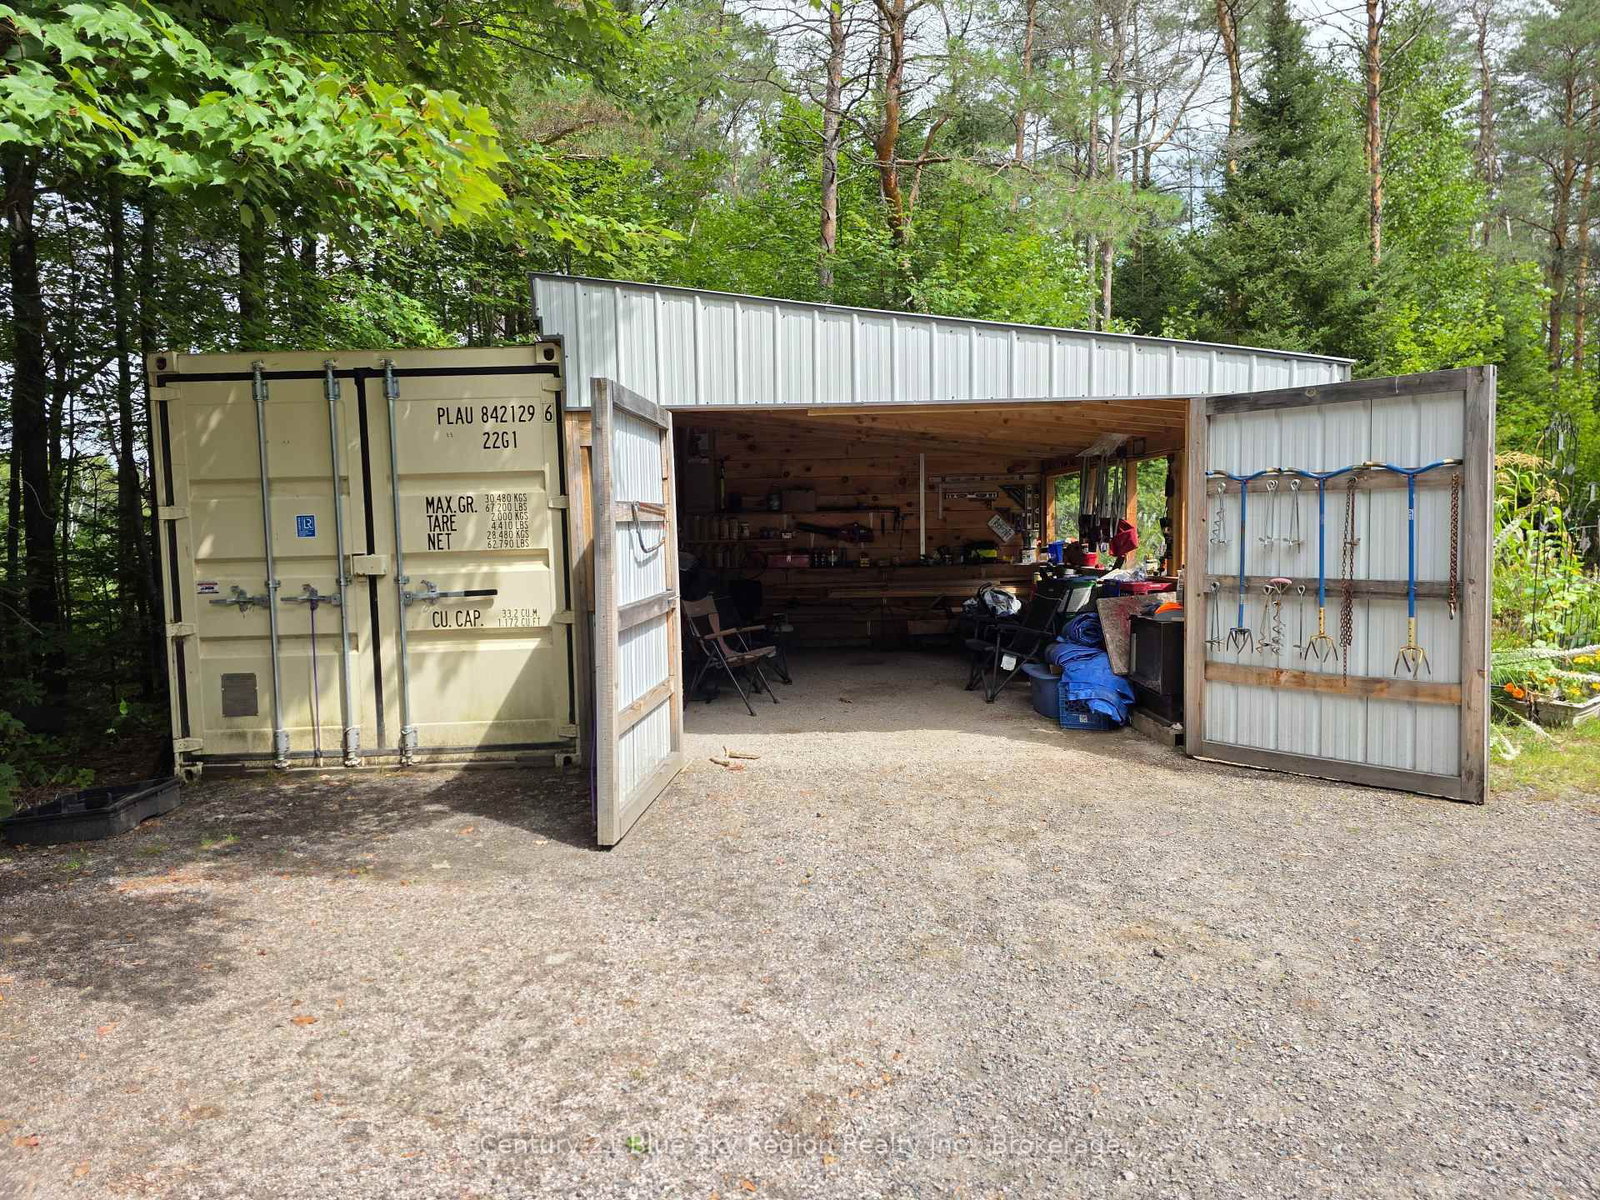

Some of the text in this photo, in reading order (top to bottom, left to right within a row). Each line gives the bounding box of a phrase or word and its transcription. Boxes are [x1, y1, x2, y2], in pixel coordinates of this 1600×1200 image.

[437, 404, 553, 425] PLAU 842129 6
[483, 431, 517, 449] 22G1
[513, 493, 527, 503] KGS
[514, 502, 527, 511] LBS
[515, 512, 528, 520] KGS
[426, 514, 457, 532] TARE
[516, 521, 529, 530] LBS
[516, 530, 529, 539] KGS
[427, 533, 452, 550] NET
[516, 539, 529, 548] LBS
[432, 610, 484, 628] CU. CAP.
